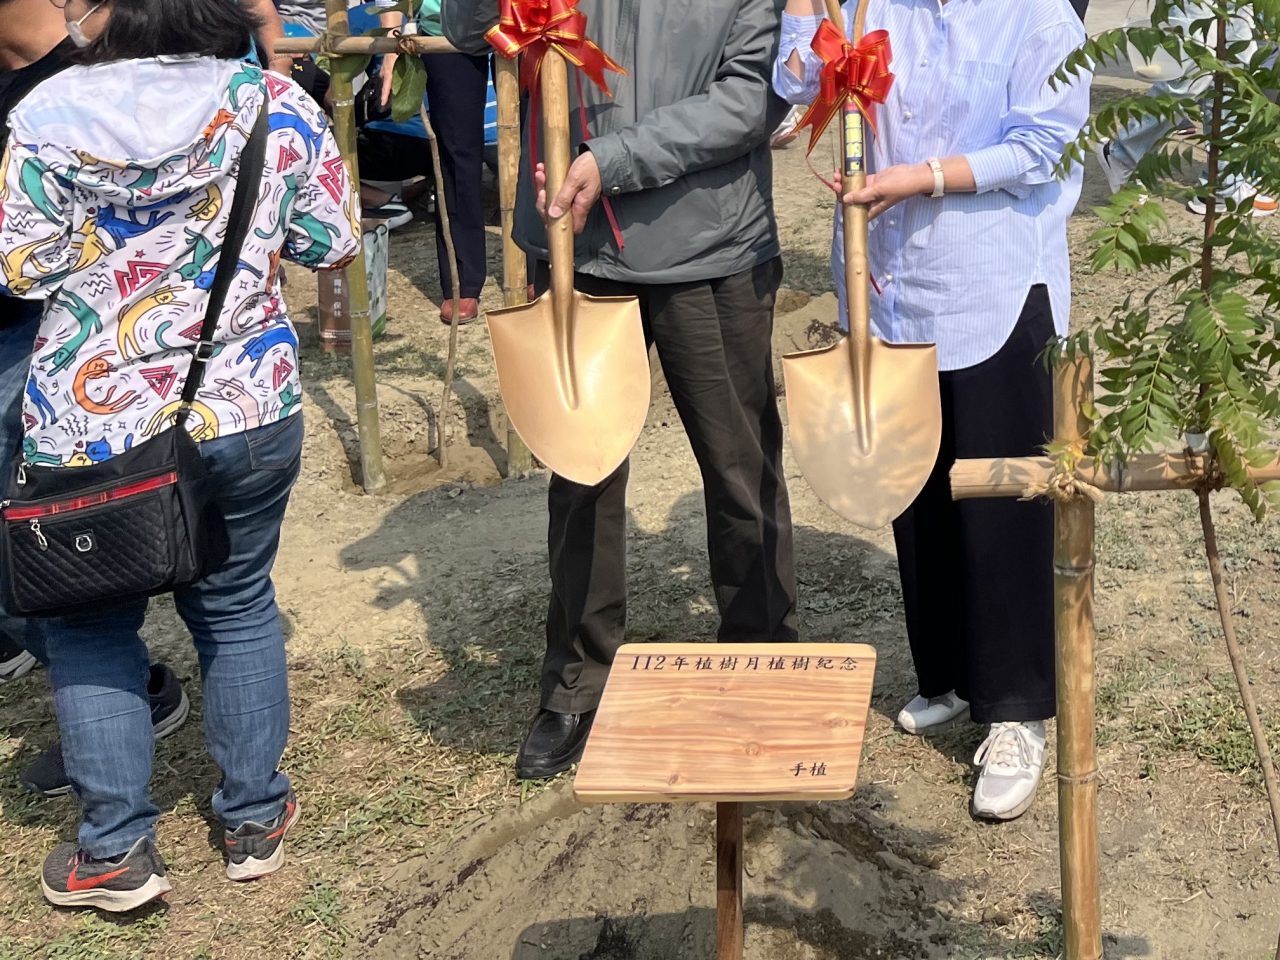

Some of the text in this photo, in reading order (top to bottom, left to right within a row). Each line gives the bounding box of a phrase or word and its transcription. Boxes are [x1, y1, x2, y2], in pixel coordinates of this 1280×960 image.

[630, 655, 860, 672] 112年植樹月植樹紀念
[789, 761, 828, 778] 手植
